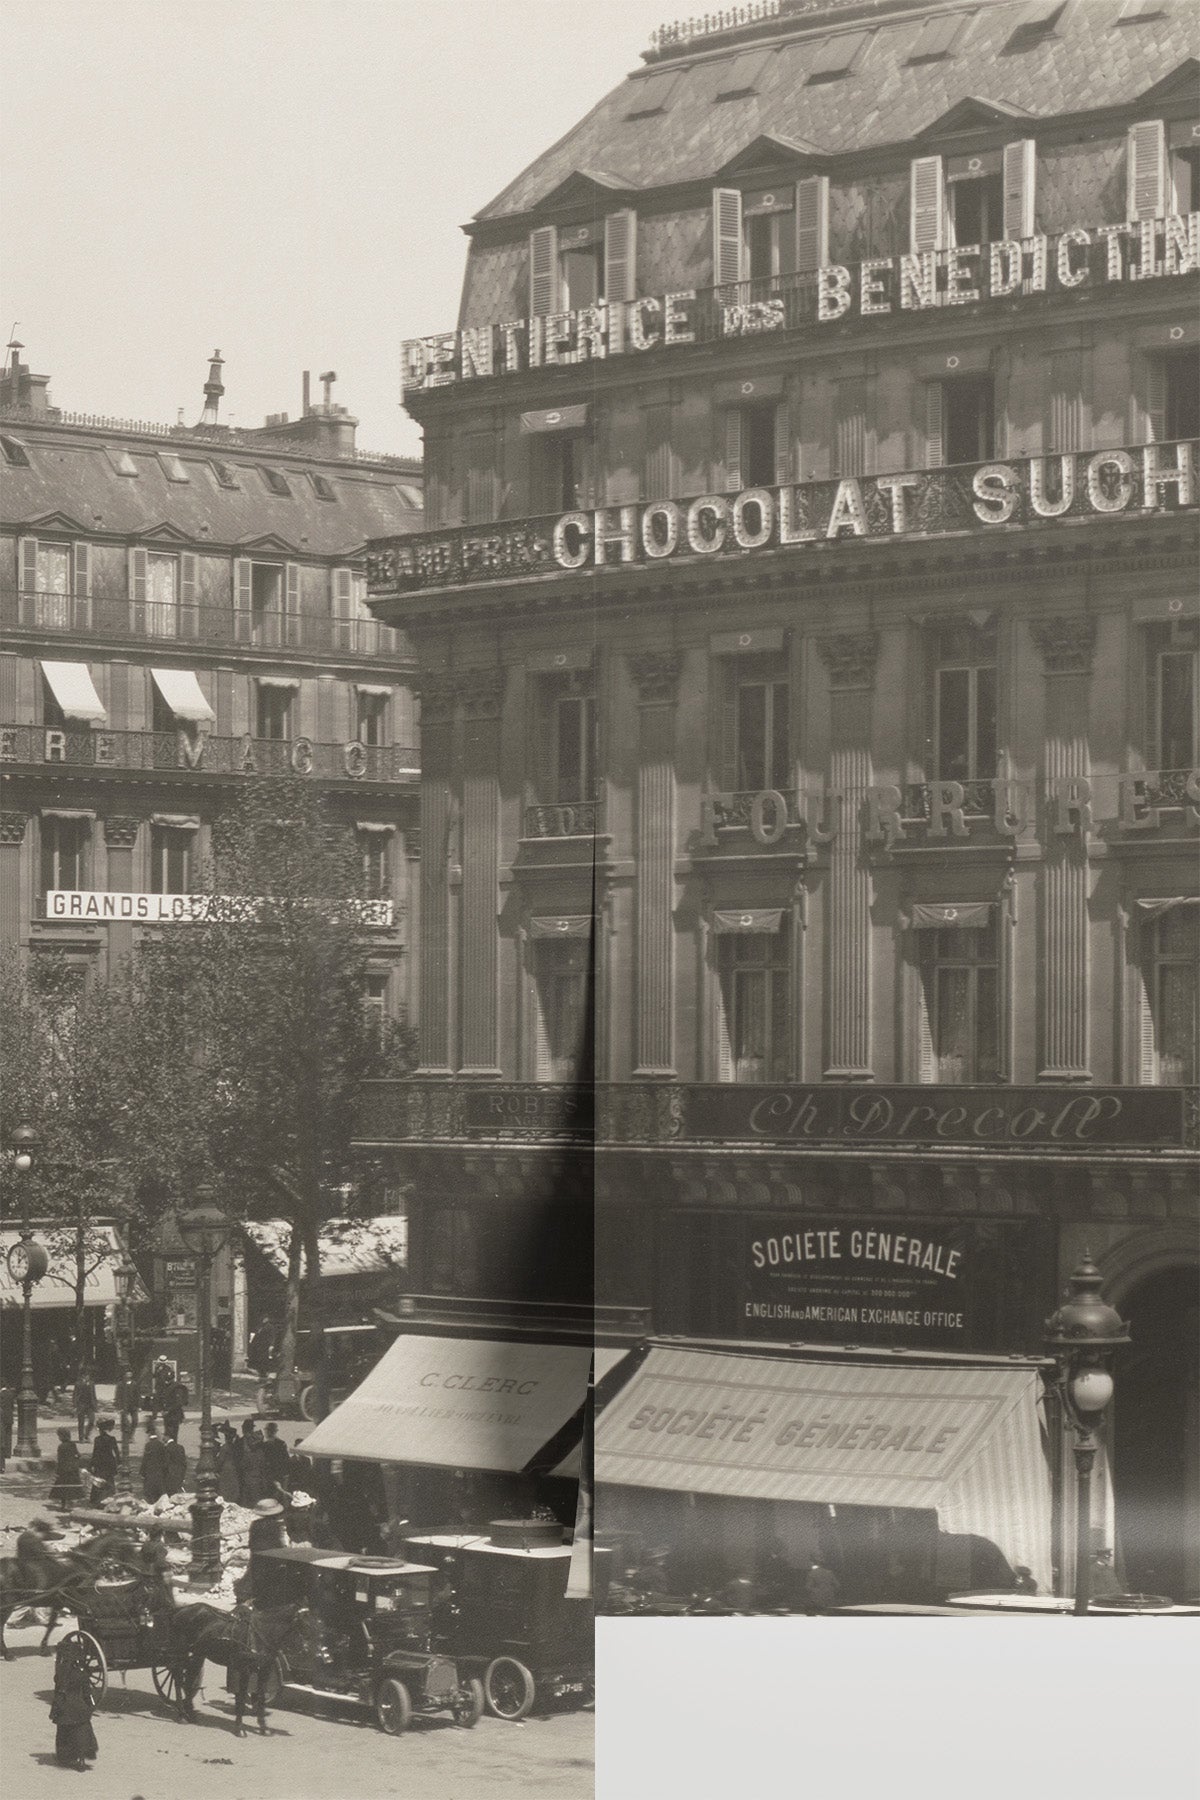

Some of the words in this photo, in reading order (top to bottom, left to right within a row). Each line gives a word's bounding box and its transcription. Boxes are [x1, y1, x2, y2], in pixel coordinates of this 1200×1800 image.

[723, 299, 785, 335] DES
[553, 473, 918, 568] CHOCOLAT
[972, 442, 1193, 523] SUCH
[53, 892, 149, 917] GRANDS
[488, 1094, 578, 1114] ROBES
[745, 1302, 791, 1320] ENGLISH
[805, 1305, 858, 1323] AMERICAN
[861, 1308, 921, 1327] EXCHANGE
[924, 1311, 963, 1328] OFFICE
[628, 1404, 769, 1444] SOCIÉTÉ
[774, 1413, 961, 1455] GÉNÉRALE
